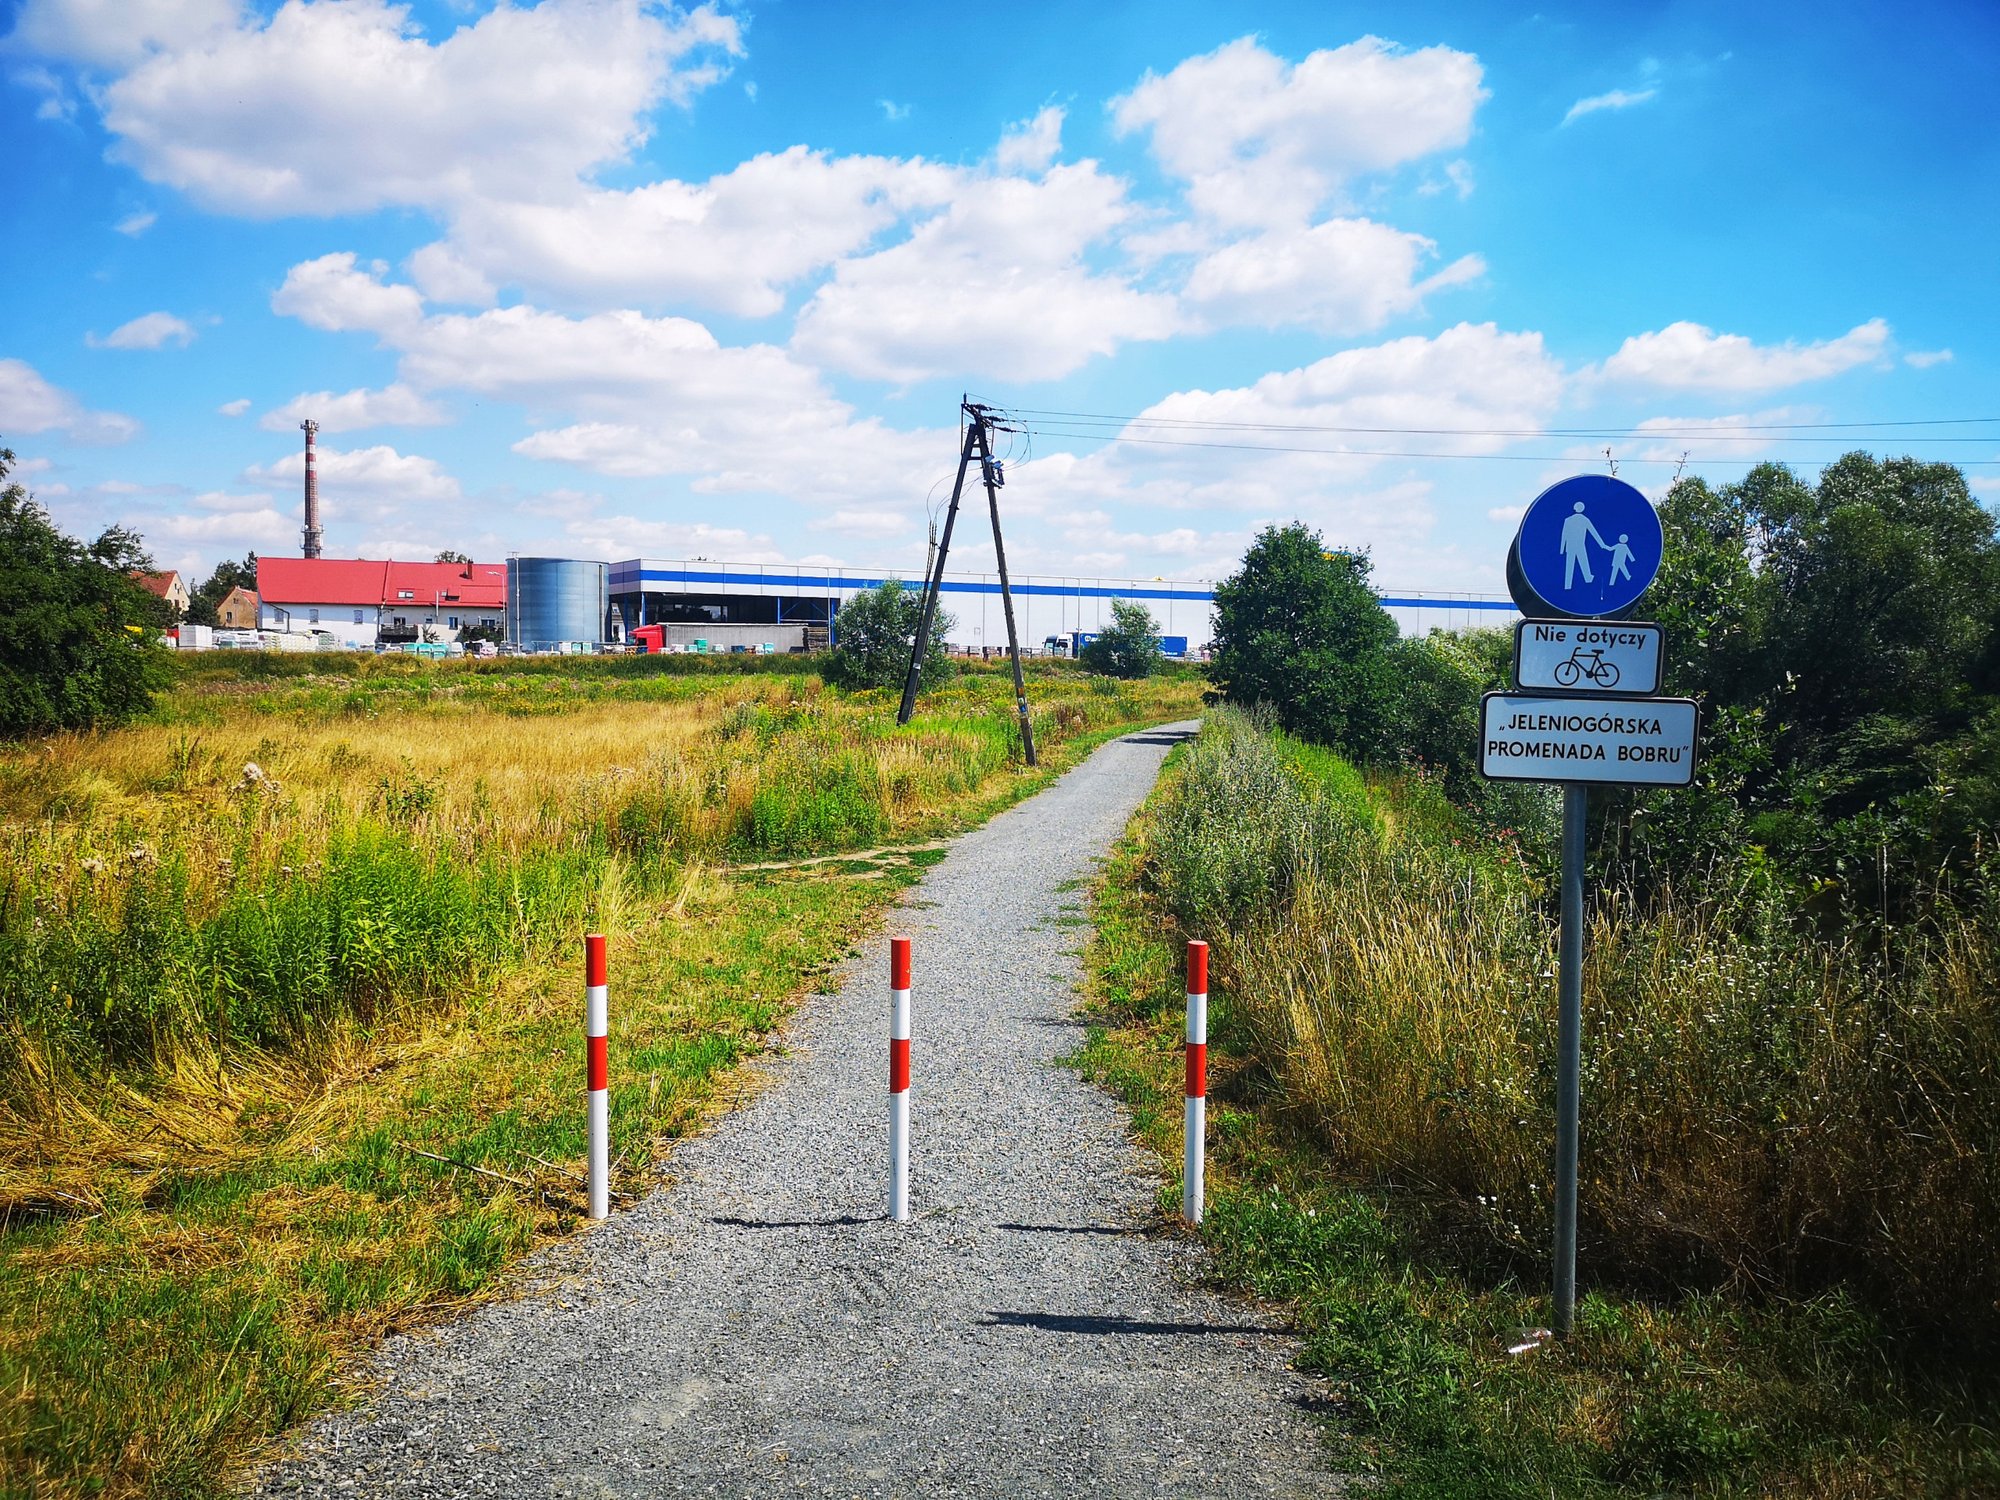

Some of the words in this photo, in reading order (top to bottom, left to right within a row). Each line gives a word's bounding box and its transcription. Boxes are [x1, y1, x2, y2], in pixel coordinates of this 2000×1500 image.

[1535, 626, 1566, 642] Nie
[1576, 627, 1646, 649] dotyczy
[1499, 713, 1662, 735] „JELENIOGÓRSKA
[1488, 741, 1606, 760] PROMENADA
[1617, 745, 1689, 763] BOBRU”
